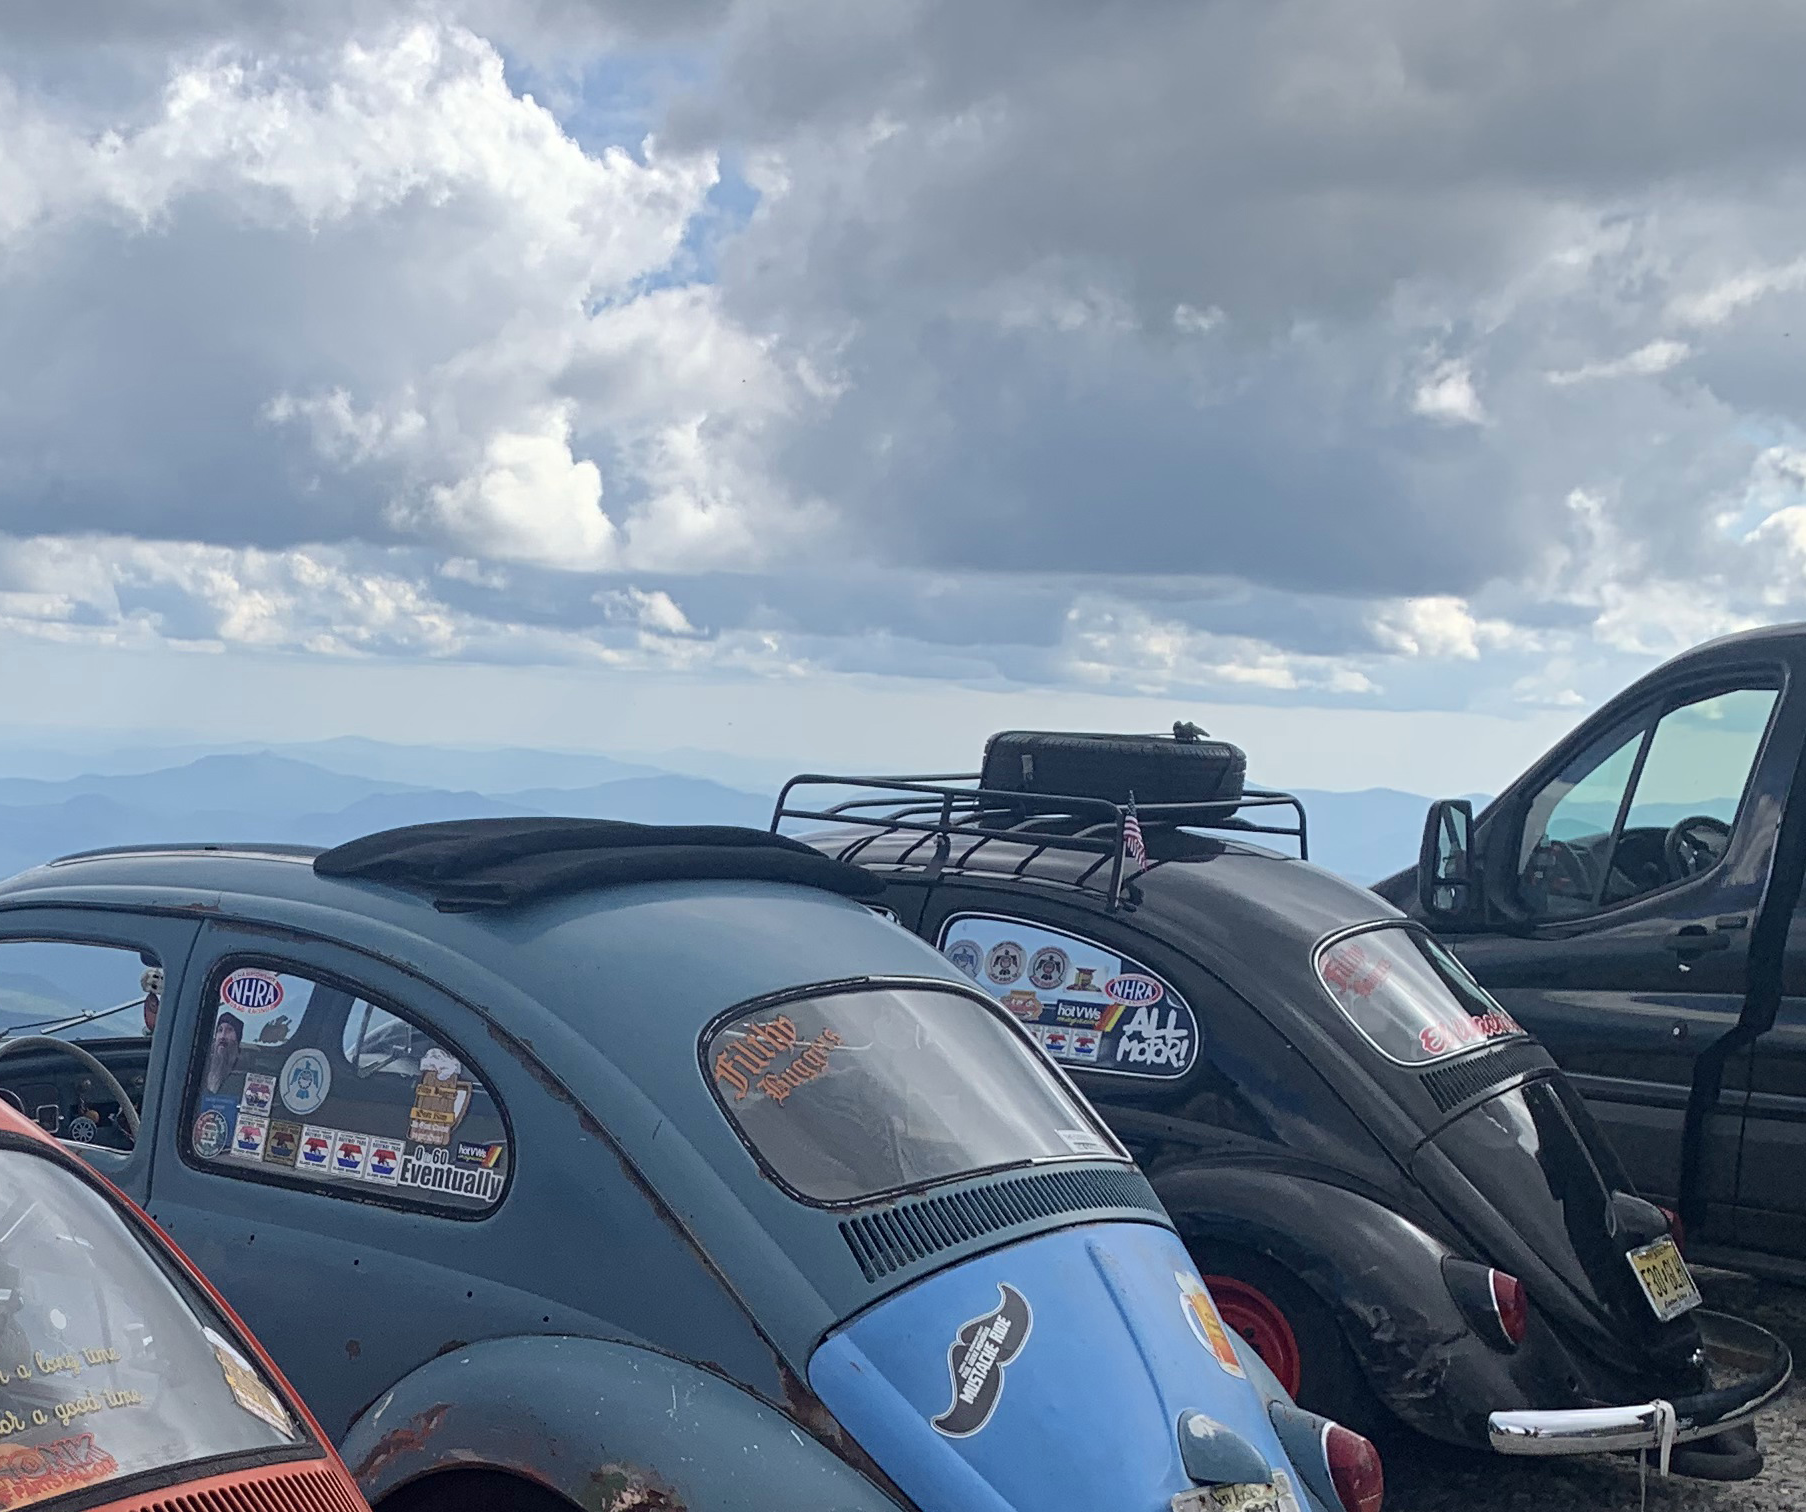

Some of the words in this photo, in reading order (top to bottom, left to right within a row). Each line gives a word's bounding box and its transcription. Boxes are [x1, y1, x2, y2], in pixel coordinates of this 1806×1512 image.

[231, 979, 275, 1006] NHRA
[1113, 981, 1153, 999] NHRA
[1123, 1007, 1188, 1041] ALL
[715, 1014, 797, 1101] Filthy
[756, 1027, 844, 1107] Buggers
[1116, 1034, 1189, 1067] MOTOR!
[416, 1147, 424, 1161] 0
[433, 1149, 448, 1165] 60
[400, 1158, 503, 1200] Eventually
[17, 1366, 32, 1379] a
[35, 1351, 81, 1375] long
[82, 1345, 121, 1365] time
[959, 1340, 1000, 1404] MUSTACHE
[989, 1314, 1012, 1344] RIDE
[32, 1410, 48, 1424] a
[55, 1395, 102, 1425] good
[103, 1387, 143, 1407] time
[12, 1474, 63, 1499] PARTS
